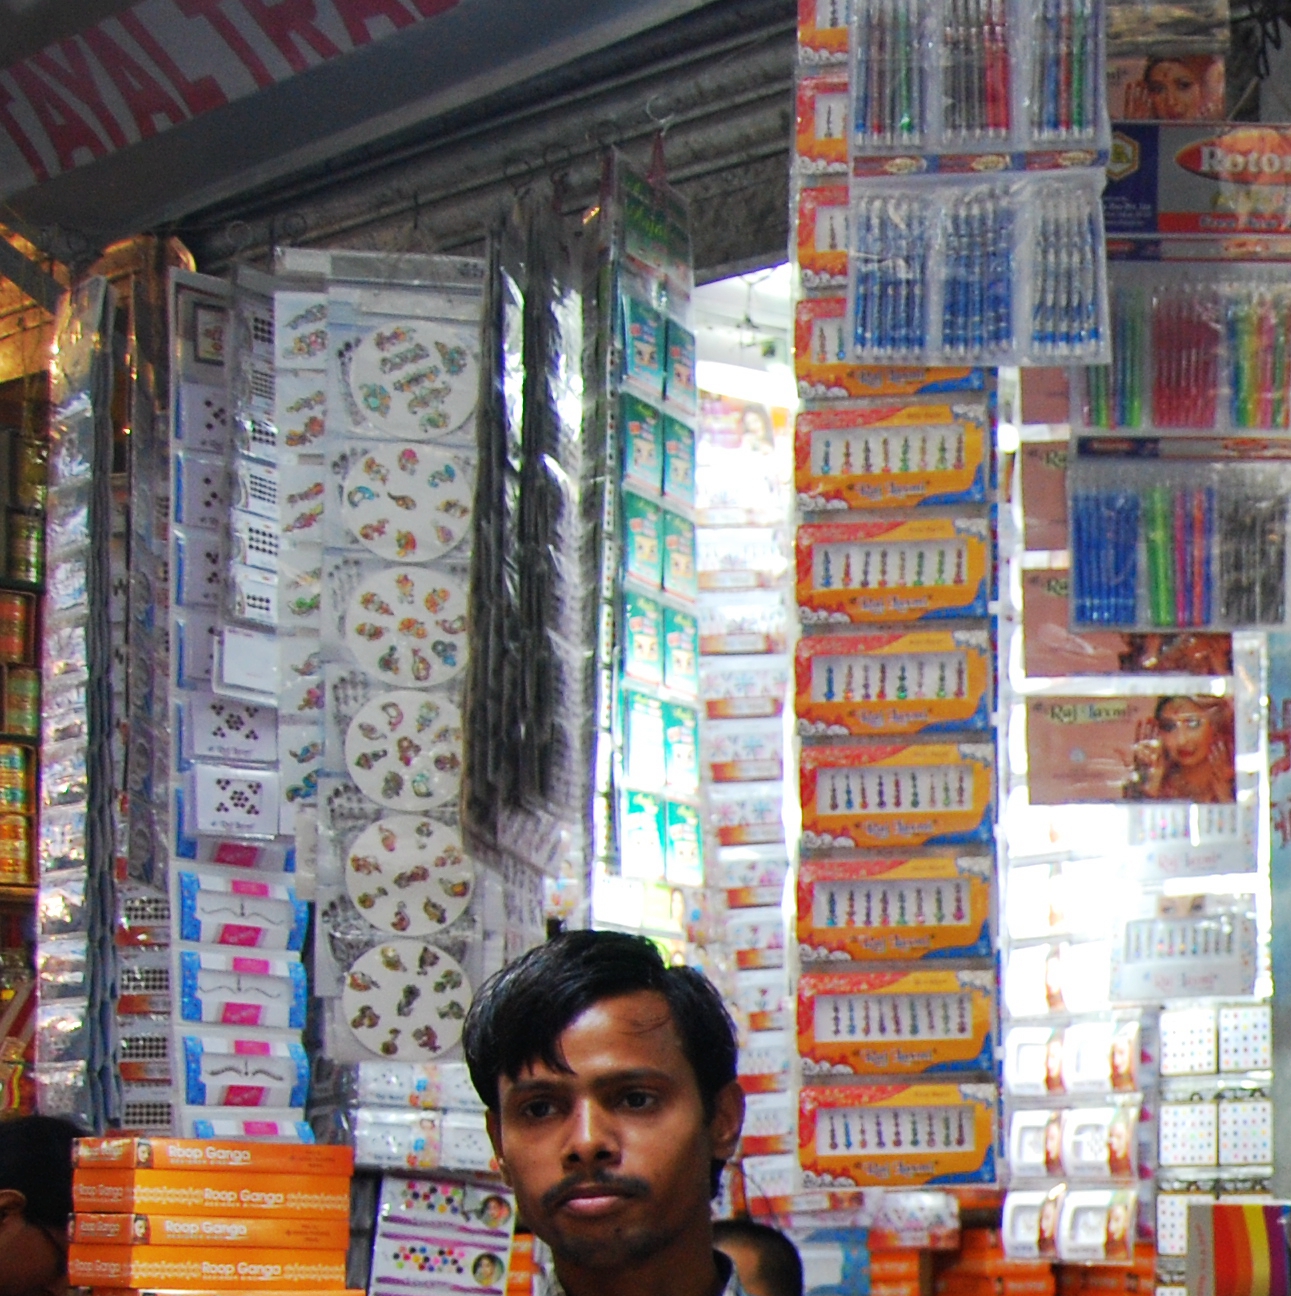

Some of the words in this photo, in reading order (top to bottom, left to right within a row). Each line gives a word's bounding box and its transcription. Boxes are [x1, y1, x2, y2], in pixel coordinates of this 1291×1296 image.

[168, 1145, 203, 1160] Roop
[206, 1146, 251, 1162] Ganga
[203, 1188, 237, 1204] Roop
[240, 1189, 284, 1205] Ganga
[164, 1219, 200, 1235] Roop
[202, 1220, 247, 1236] Ganga
[201, 1261, 235, 1276] Roop
[237, 1261, 282, 1278] Ganga
